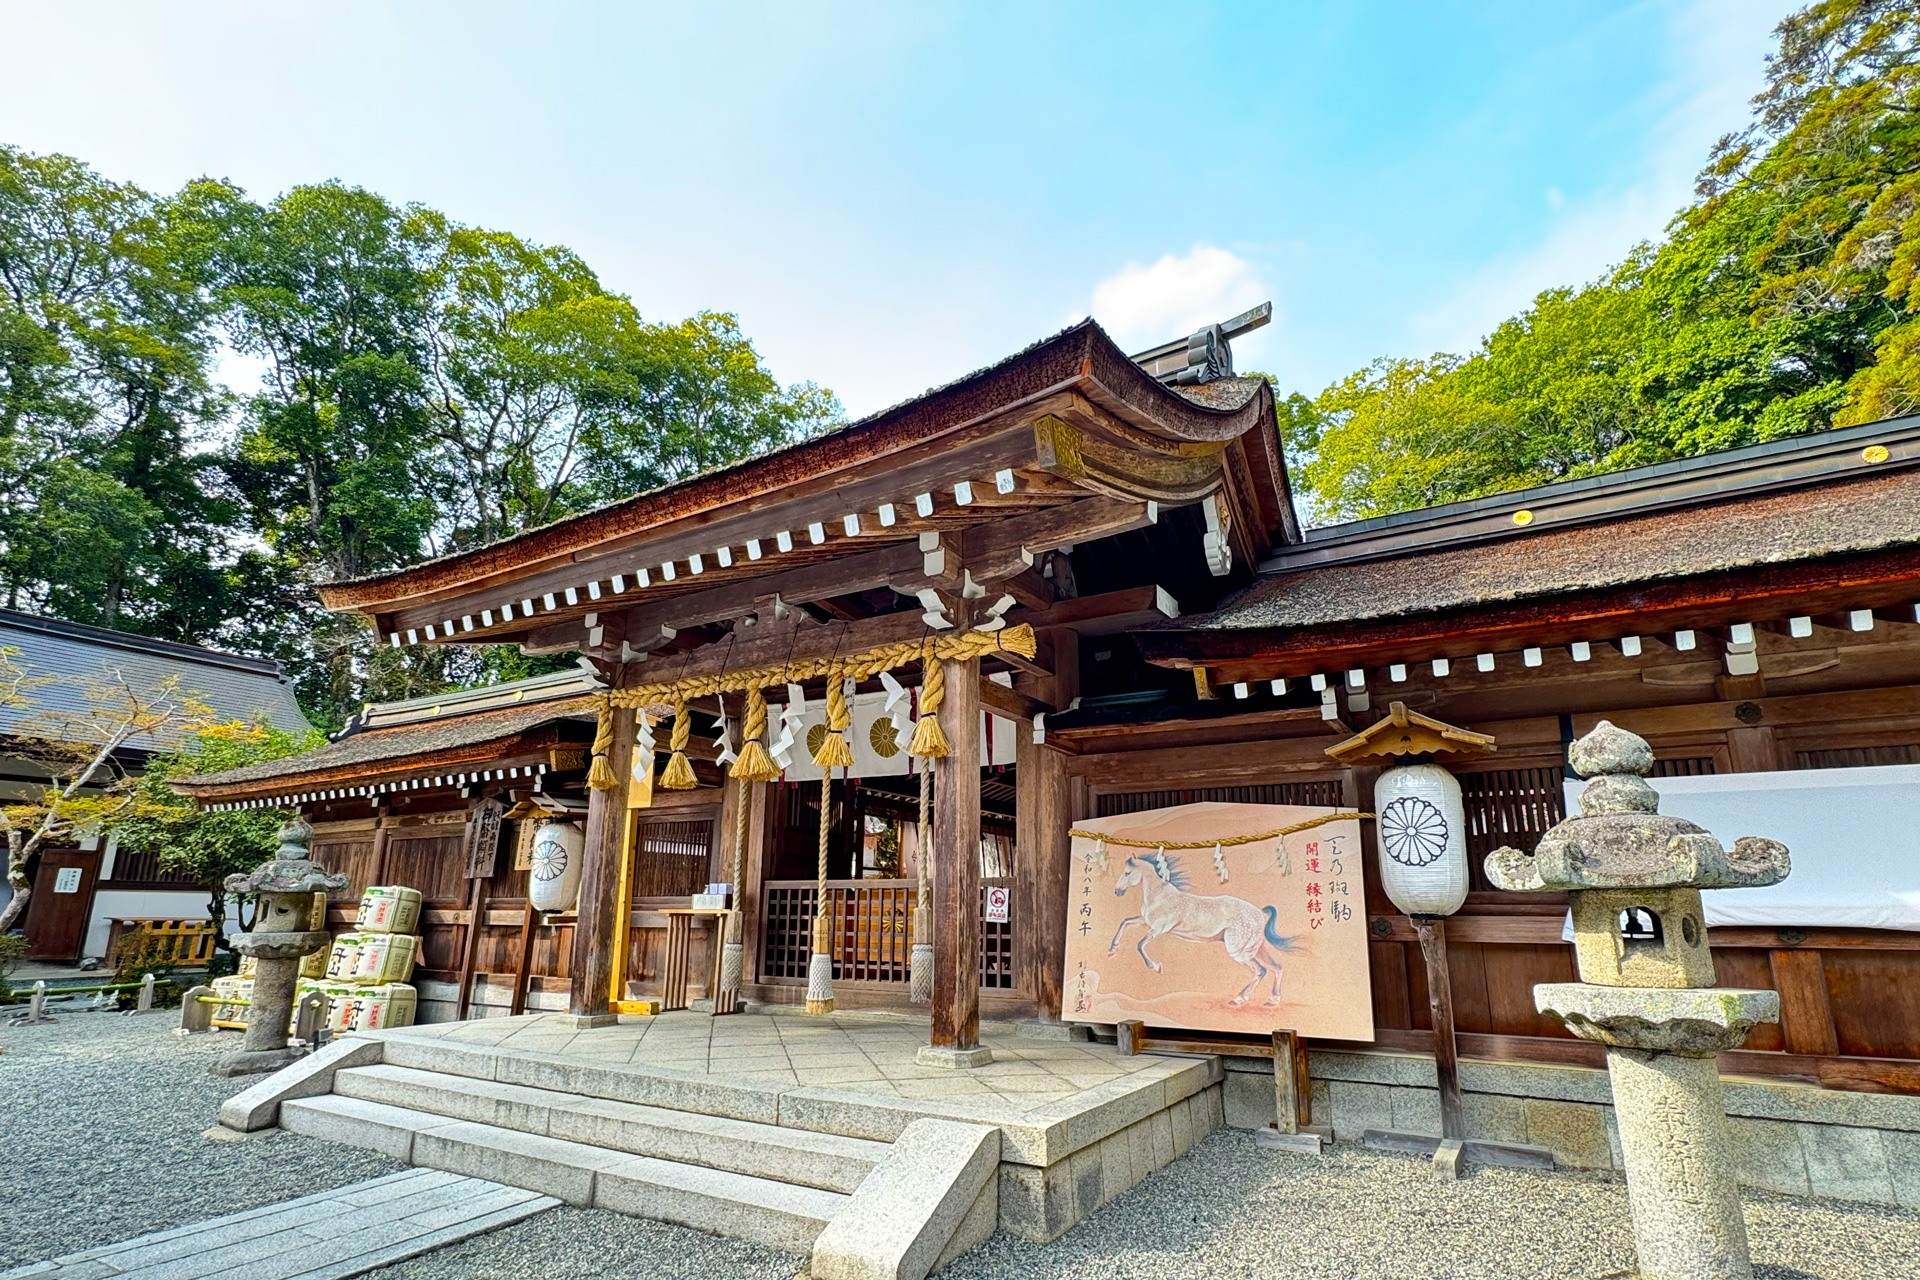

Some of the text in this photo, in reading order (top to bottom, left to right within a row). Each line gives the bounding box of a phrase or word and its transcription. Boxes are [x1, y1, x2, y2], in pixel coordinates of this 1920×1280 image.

[1079, 853, 1093, 937] 令和八年 丙午
[1305, 842, 1324, 930] 開運 縁結び
